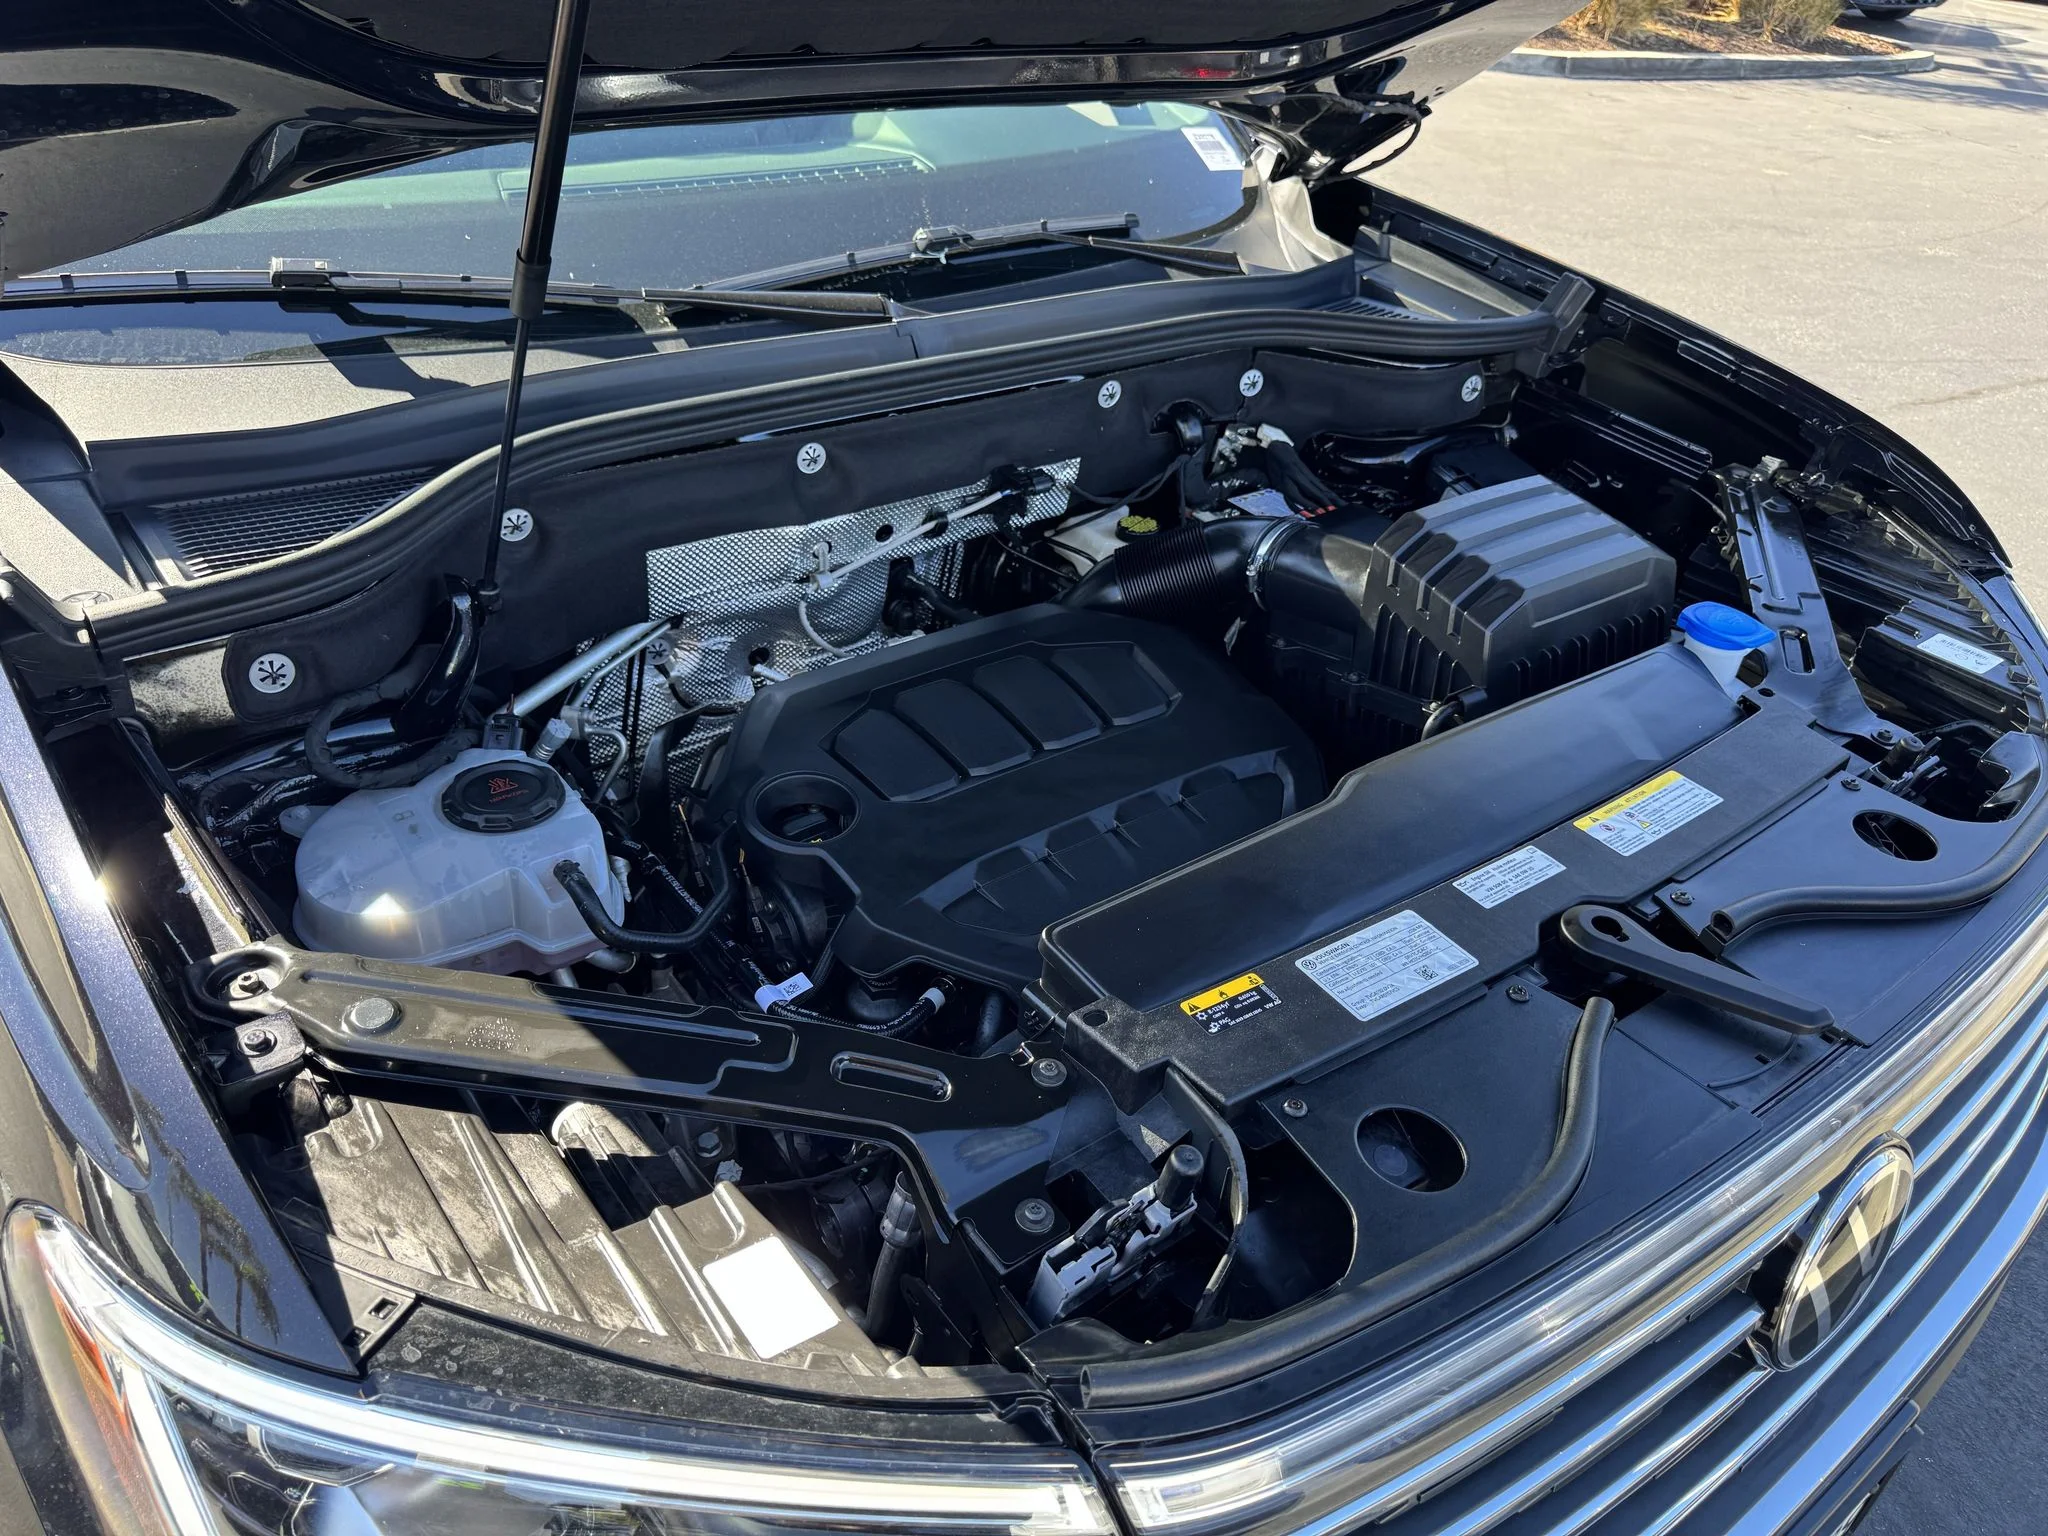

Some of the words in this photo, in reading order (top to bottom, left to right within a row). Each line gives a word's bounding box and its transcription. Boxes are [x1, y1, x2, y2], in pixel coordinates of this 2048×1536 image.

[1313, 942, 1350, 962] VOLKSWAGEN
[1319, 956, 1335, 966] VEHICLE
[1334, 946, 1355, 958] EMISSION
[1353, 939, 1372, 949] CONTROL
[1371, 926, 1398, 941] INFORMATION
[1343, 978, 1369, 993] adjustments
[1367, 971, 1383, 980] needed
[1207, 1001, 1231, 1015] R-1234yf
[1218, 1016, 1231, 1025] PAG
